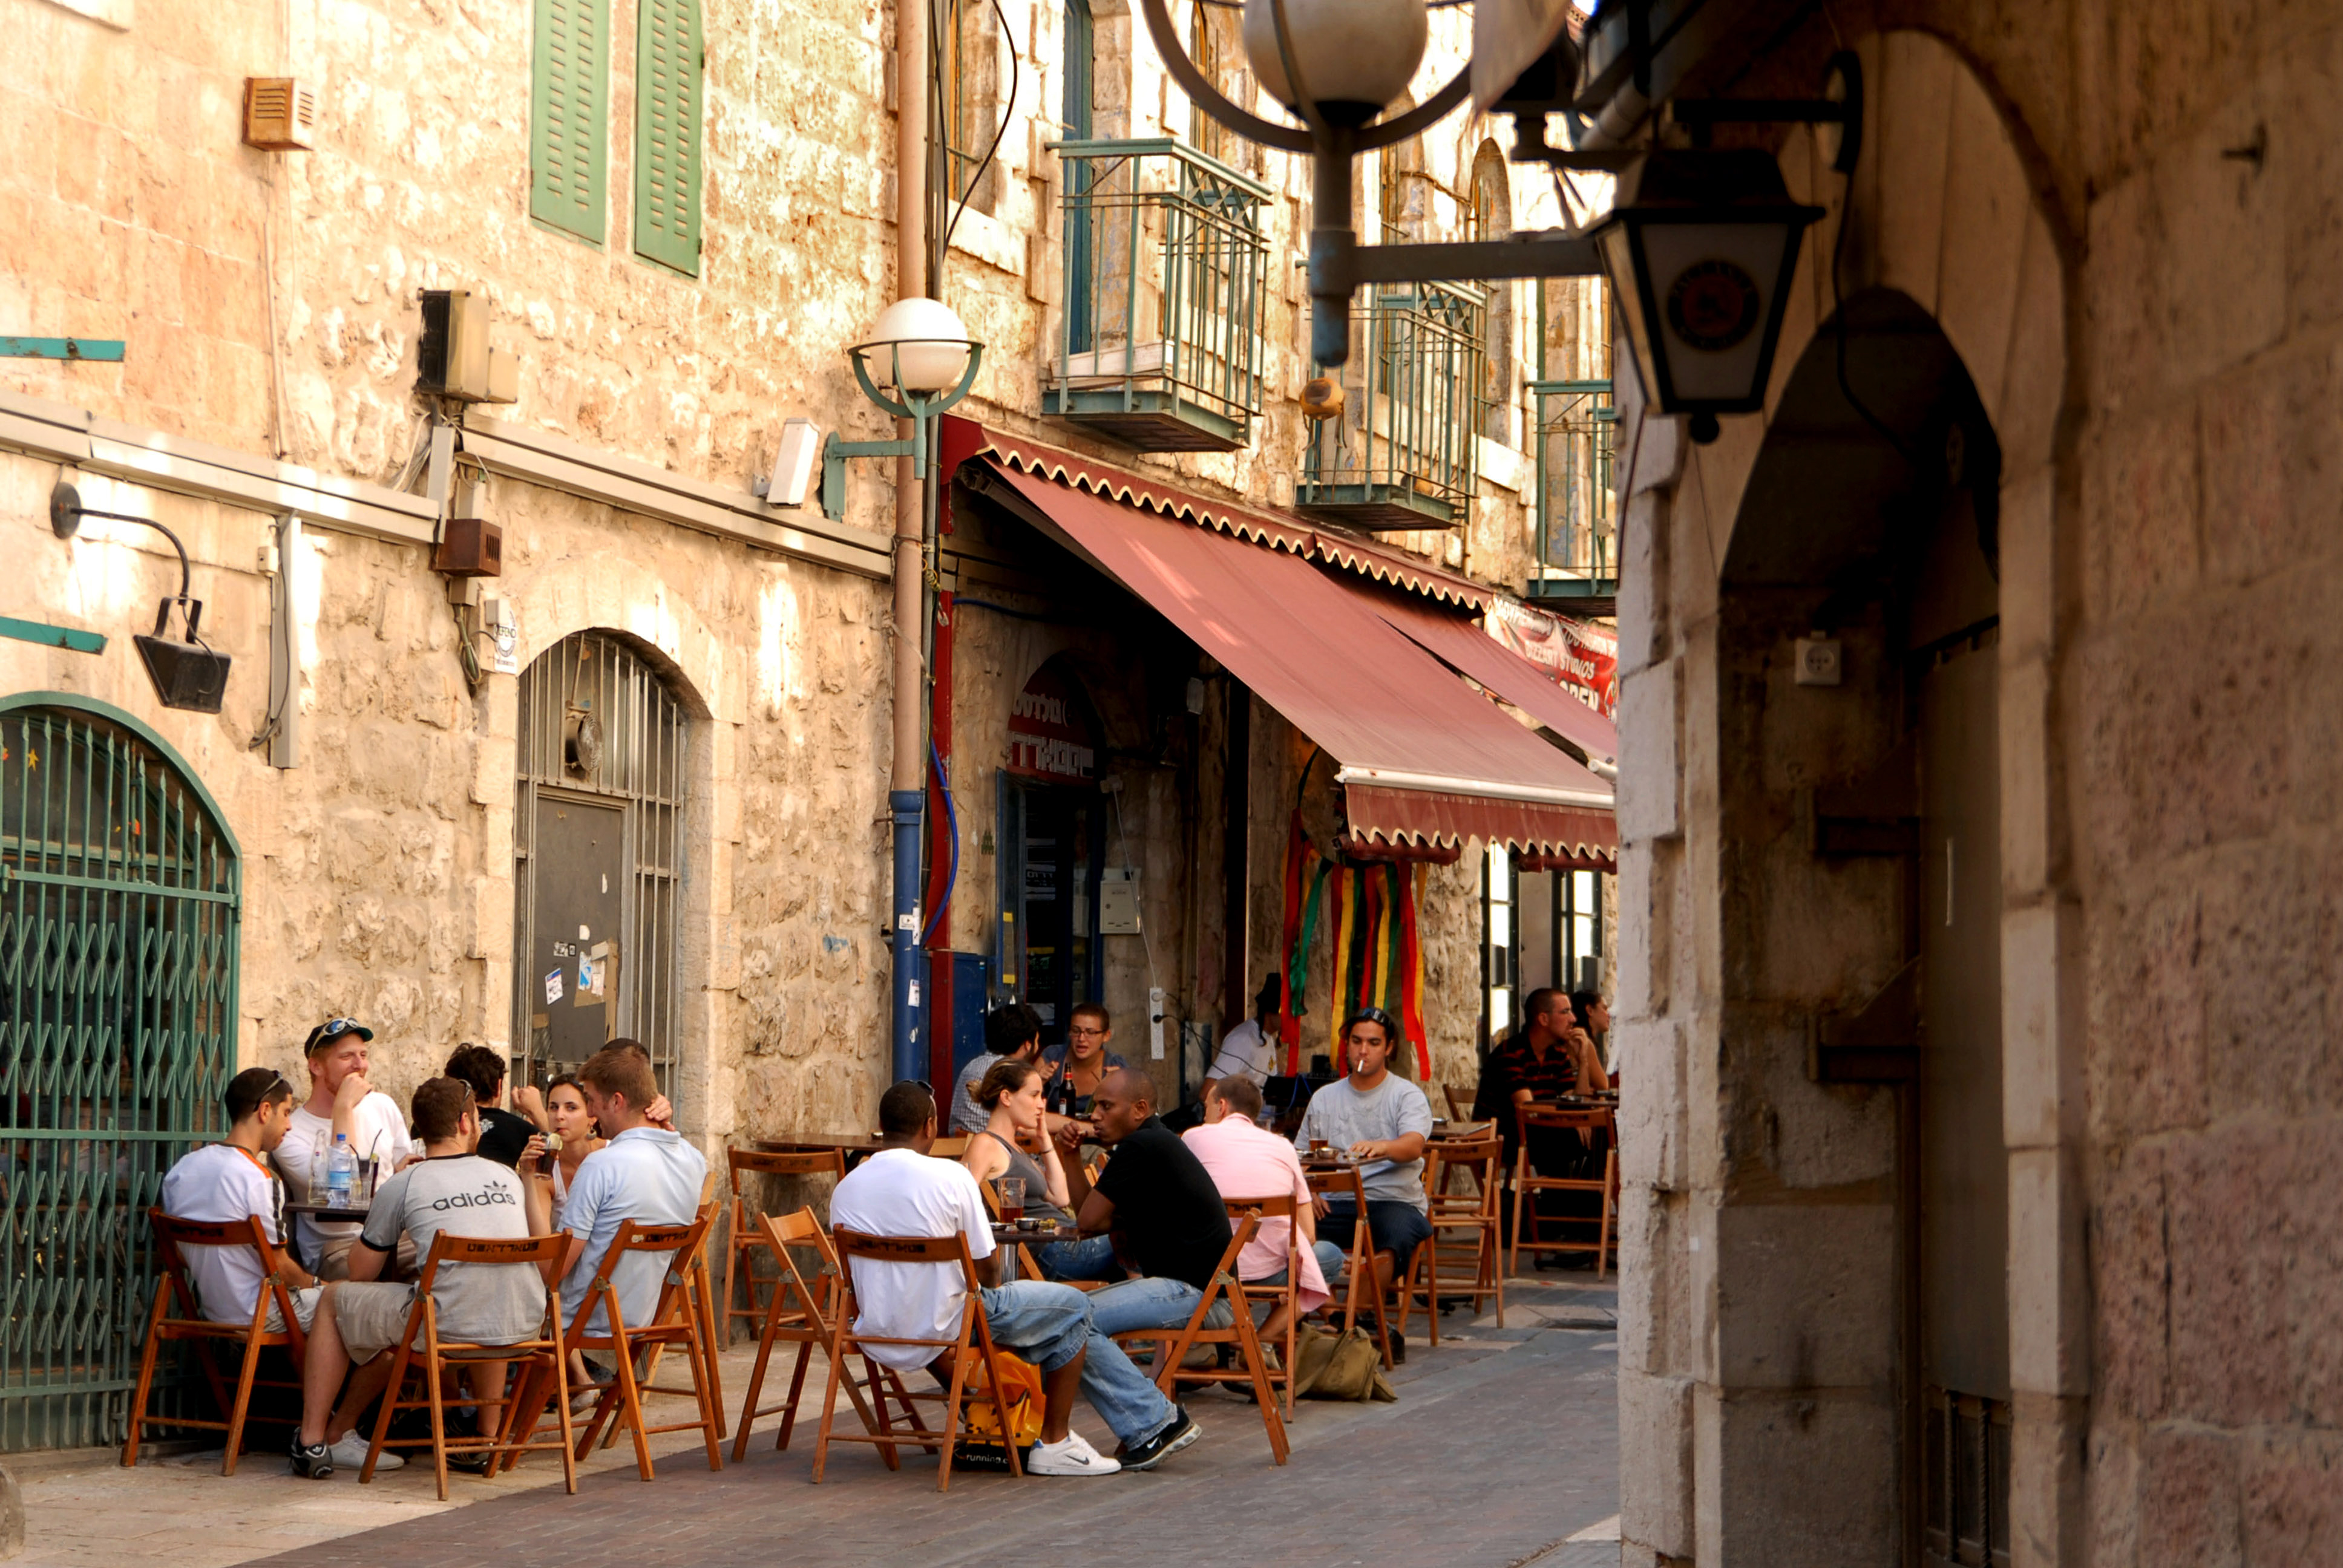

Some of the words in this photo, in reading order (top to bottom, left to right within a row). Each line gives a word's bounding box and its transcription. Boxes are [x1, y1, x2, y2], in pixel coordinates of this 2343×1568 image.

[1559, 653, 1595, 680] STUDIOS
[433, 1191, 516, 1211] adidas
[966, 1454, 1009, 1465] running.c
